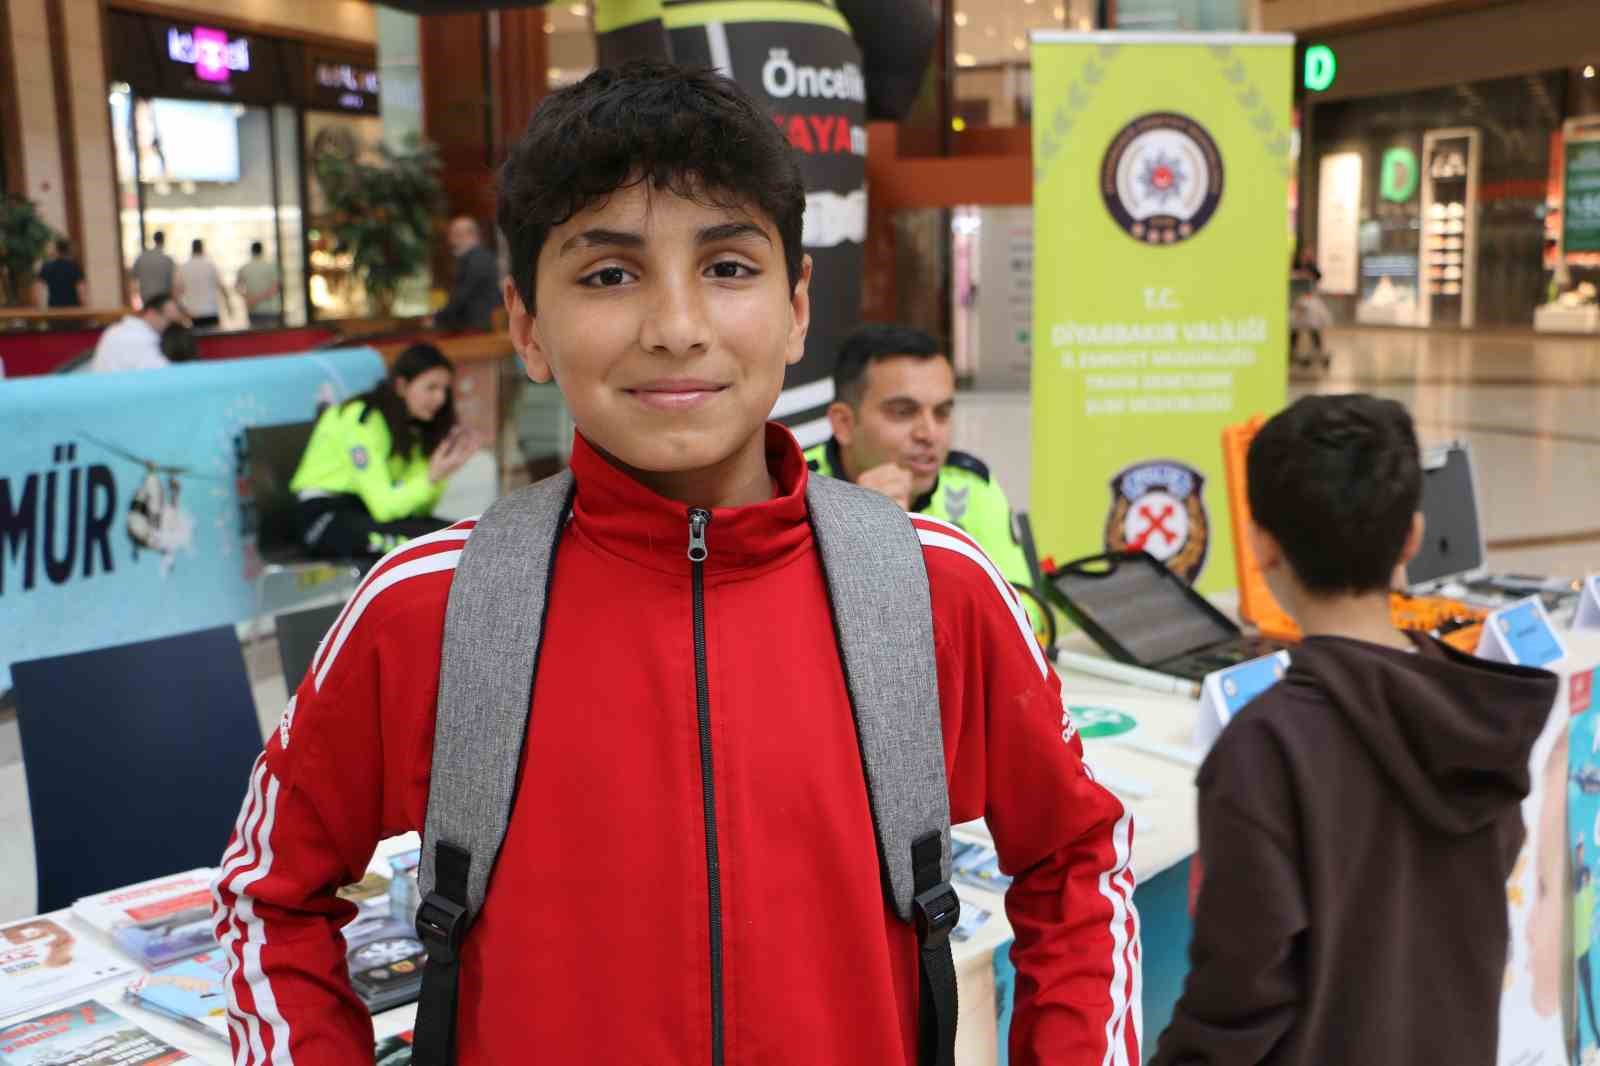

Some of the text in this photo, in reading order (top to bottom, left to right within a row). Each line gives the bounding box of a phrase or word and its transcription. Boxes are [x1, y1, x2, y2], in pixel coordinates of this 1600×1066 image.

[1304, 45, 1336, 91] D
[1380, 147, 1419, 203] D
[0, 442, 118, 595] MÜR
